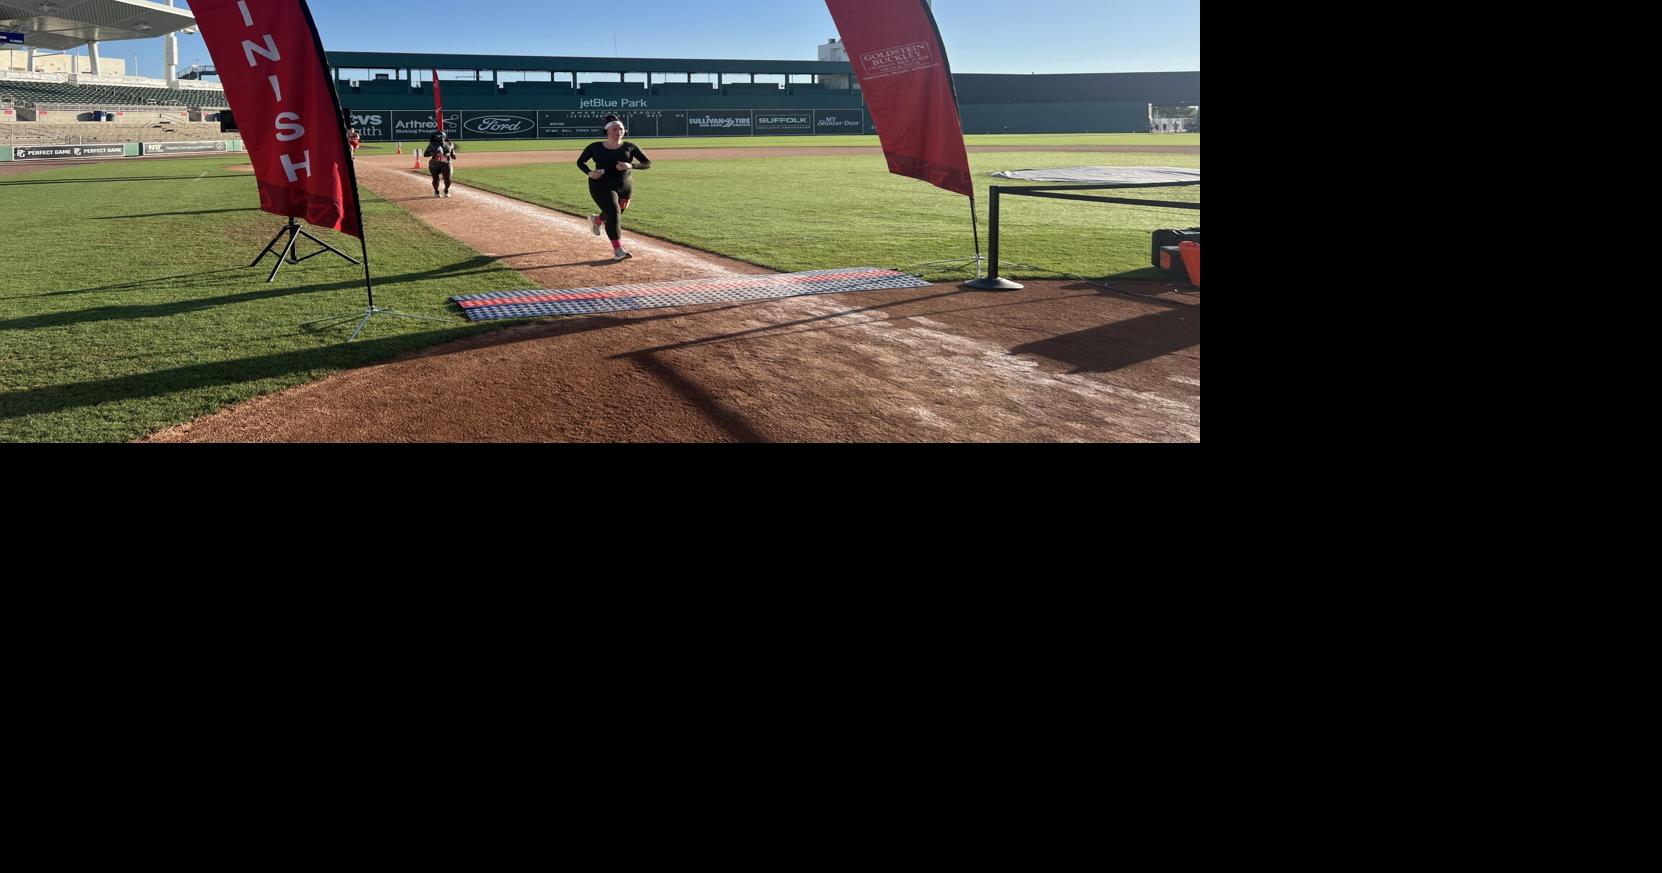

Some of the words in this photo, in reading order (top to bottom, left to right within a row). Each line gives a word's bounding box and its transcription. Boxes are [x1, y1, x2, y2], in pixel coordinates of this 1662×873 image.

[864, 43, 925, 61] GOLDSTEIN
[872, 51, 920, 66] BUCKLEY
[579, 98, 618, 109] jetBlue
[621, 98, 647, 107] Park
[478, 116, 522, 131] Ford
